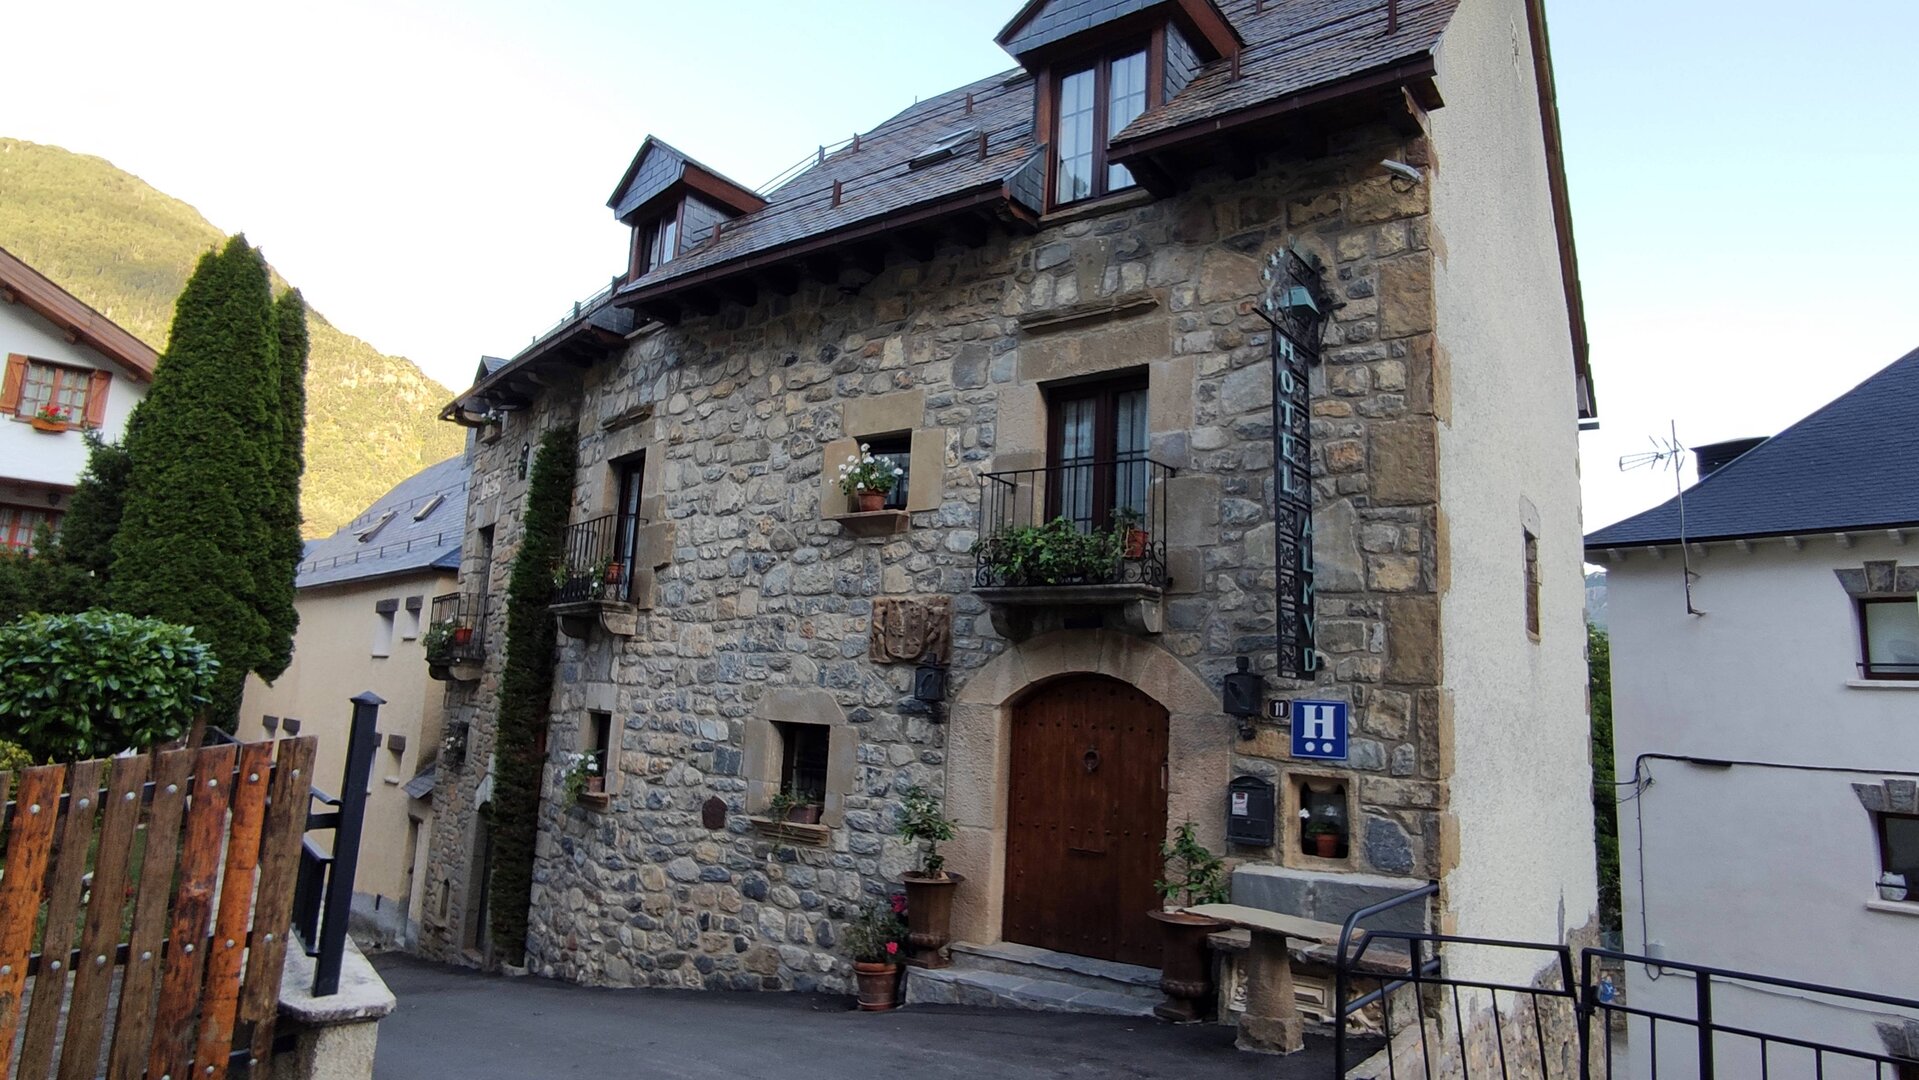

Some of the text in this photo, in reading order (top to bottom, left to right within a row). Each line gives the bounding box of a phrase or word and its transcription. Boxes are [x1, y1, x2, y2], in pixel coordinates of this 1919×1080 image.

[1279, 335, 1296, 495] HOTEL
[1275, 702, 1284, 716] 11
[1302, 705, 1336, 739] H
